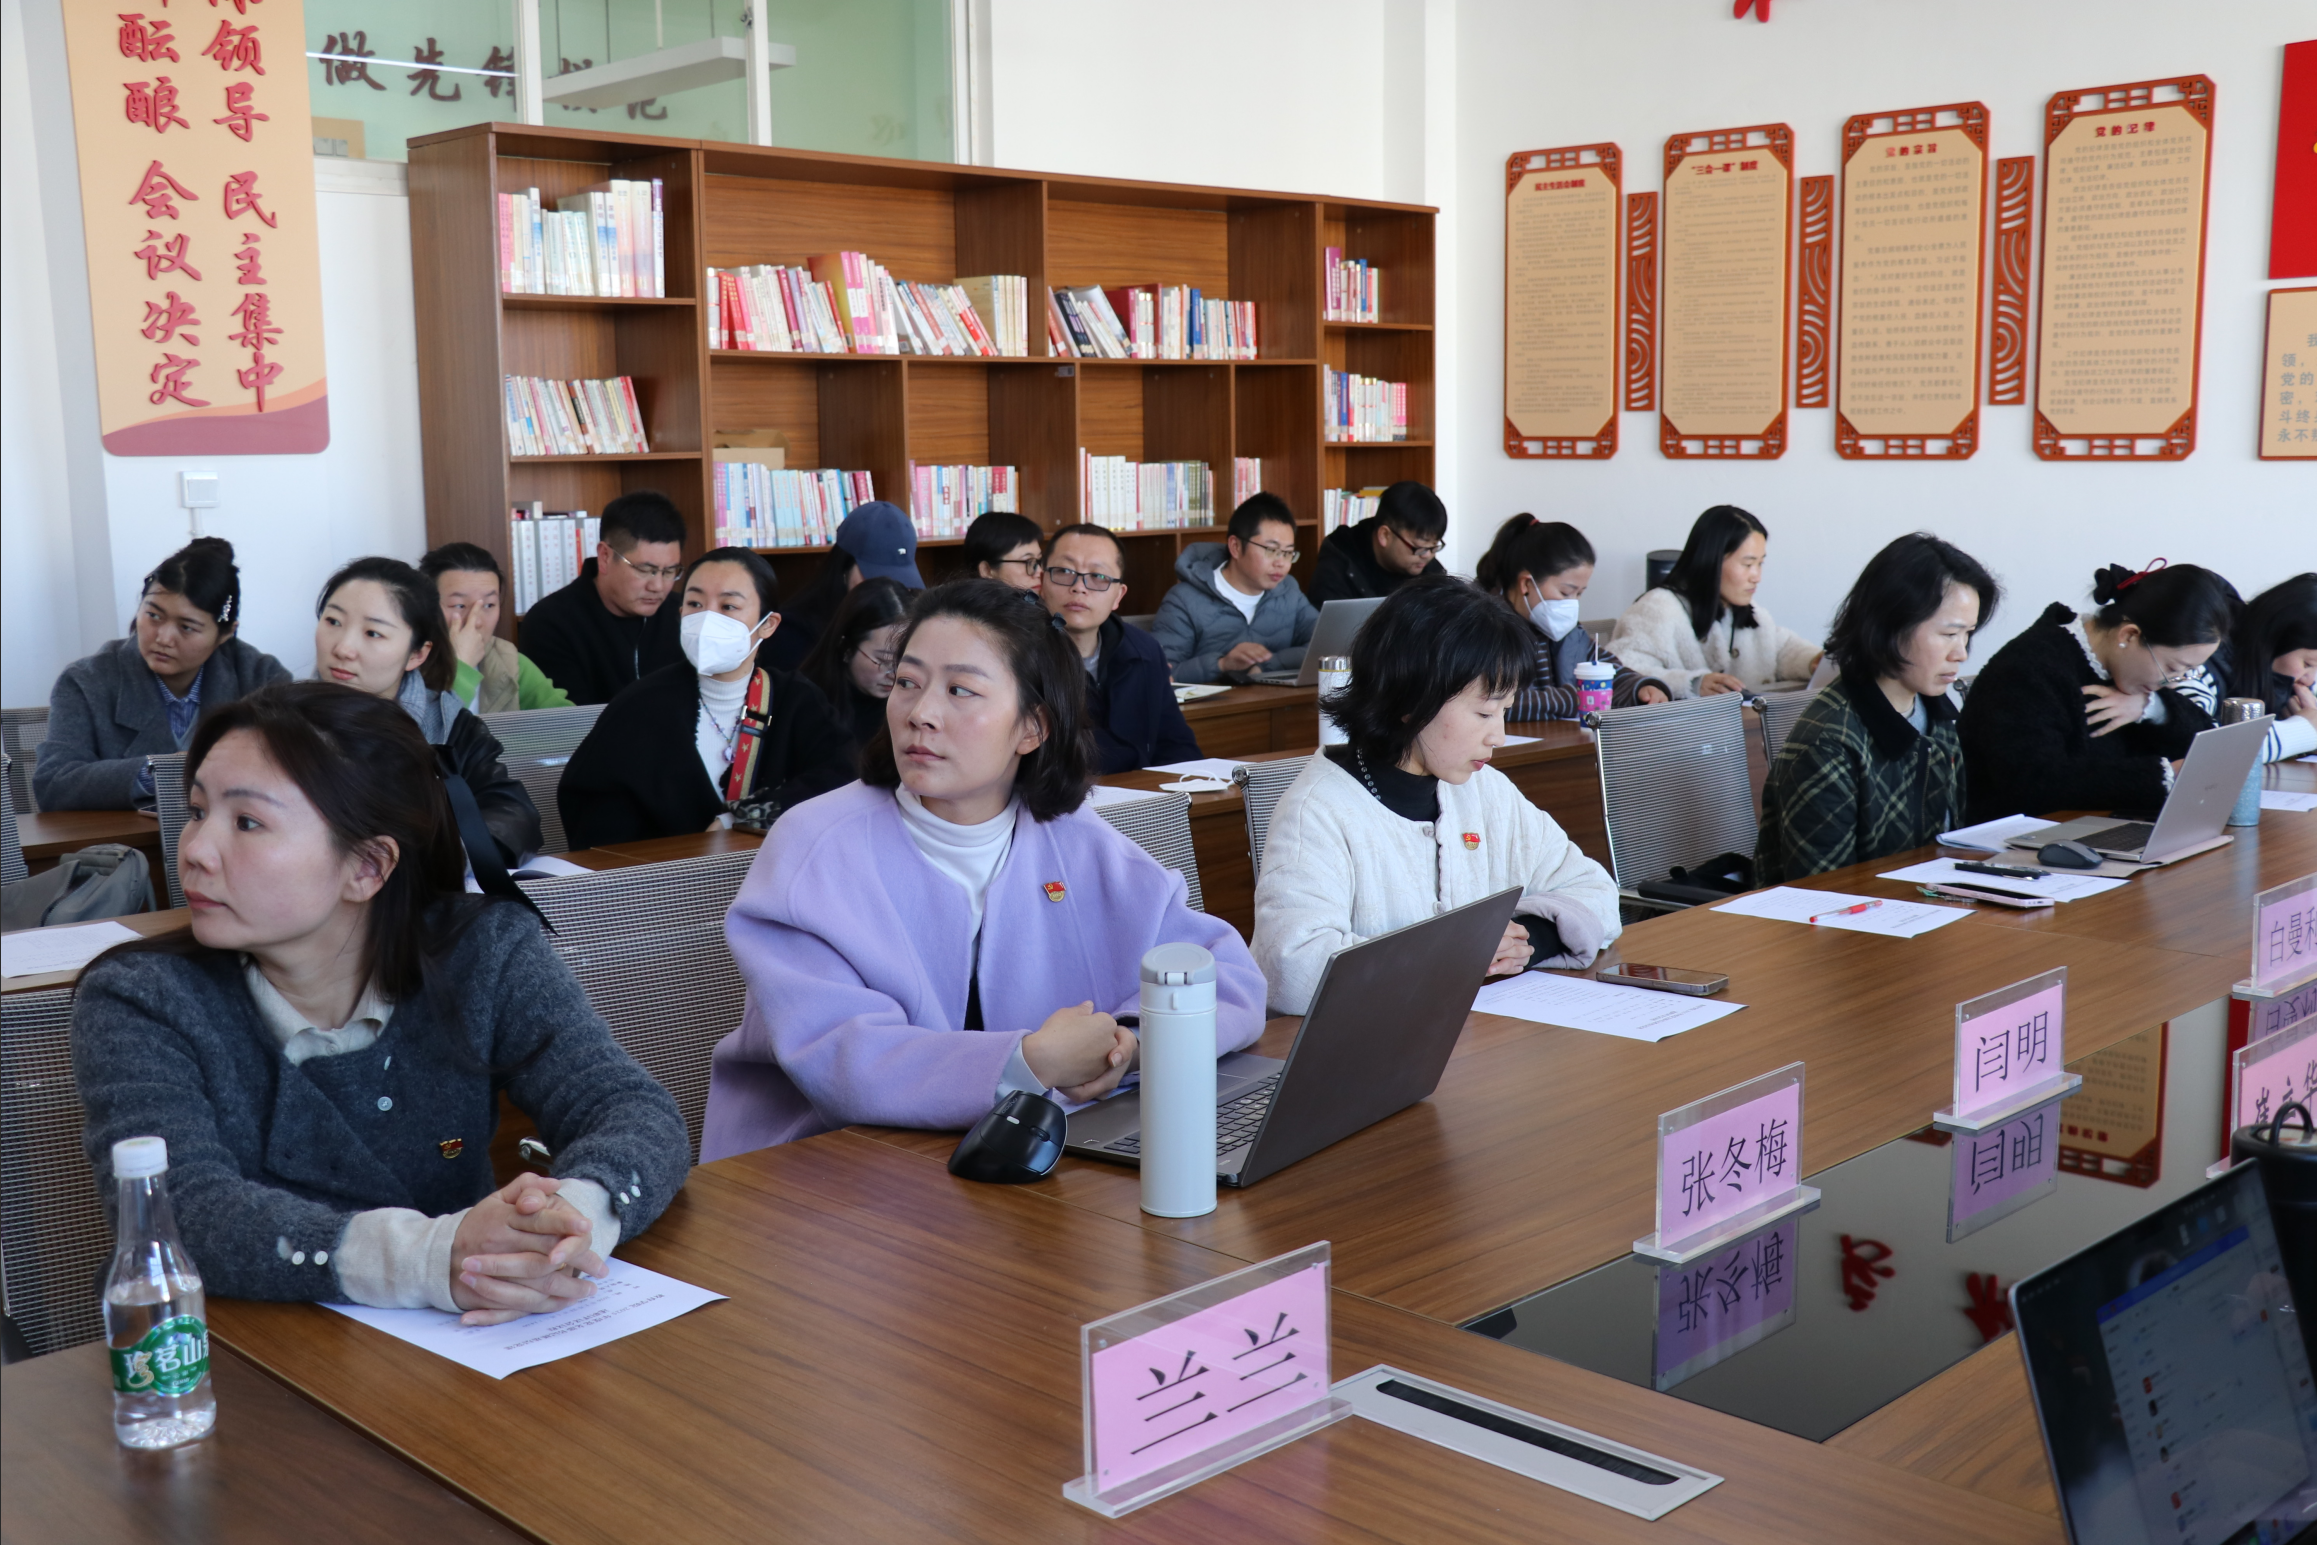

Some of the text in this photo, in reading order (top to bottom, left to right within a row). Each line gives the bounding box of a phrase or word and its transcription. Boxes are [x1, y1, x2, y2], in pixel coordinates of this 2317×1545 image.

[117, 0, 212, 408] 酝酿 会议决定
[201, 0, 285, 413] 领导 民主集中
[2278, 409, 2317, 424] 斗终
[2279, 391, 2317, 406] 密，
[2280, 372, 2315, 387] 党的
[1975, 1010, 2048, 1093] 闫明
[1682, 1118, 1788, 1217] 张冬梅
[1130, 1312, 1308, 1455] 兰兰
